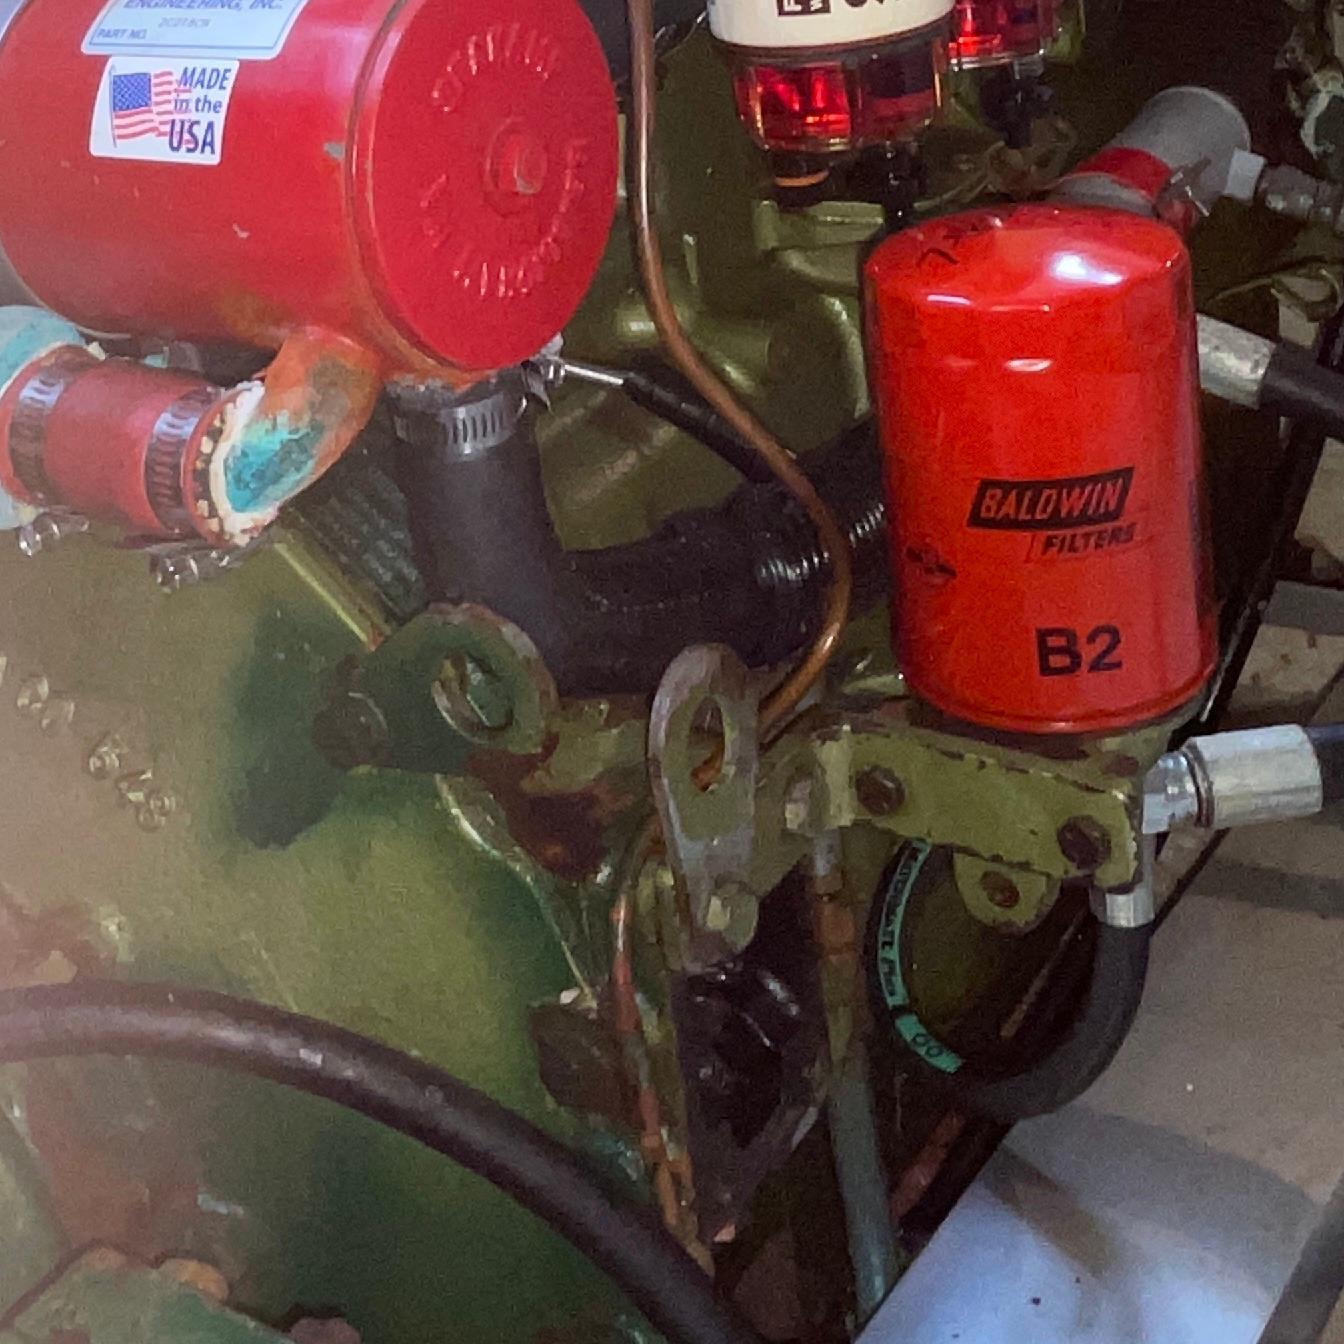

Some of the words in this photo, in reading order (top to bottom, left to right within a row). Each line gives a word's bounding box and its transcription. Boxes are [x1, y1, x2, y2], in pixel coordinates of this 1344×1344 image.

[97, 29, 127, 39] PART
[180, 67, 232, 90] MADE
[174, 95, 191, 111] in
[194, 96, 223, 114] the
[168, 118, 216, 155] USA
[979, 477, 1124, 521] BALDWIN
[1042, 522, 1138, 556] FILTERS
[1034, 624, 1123, 676] B2
